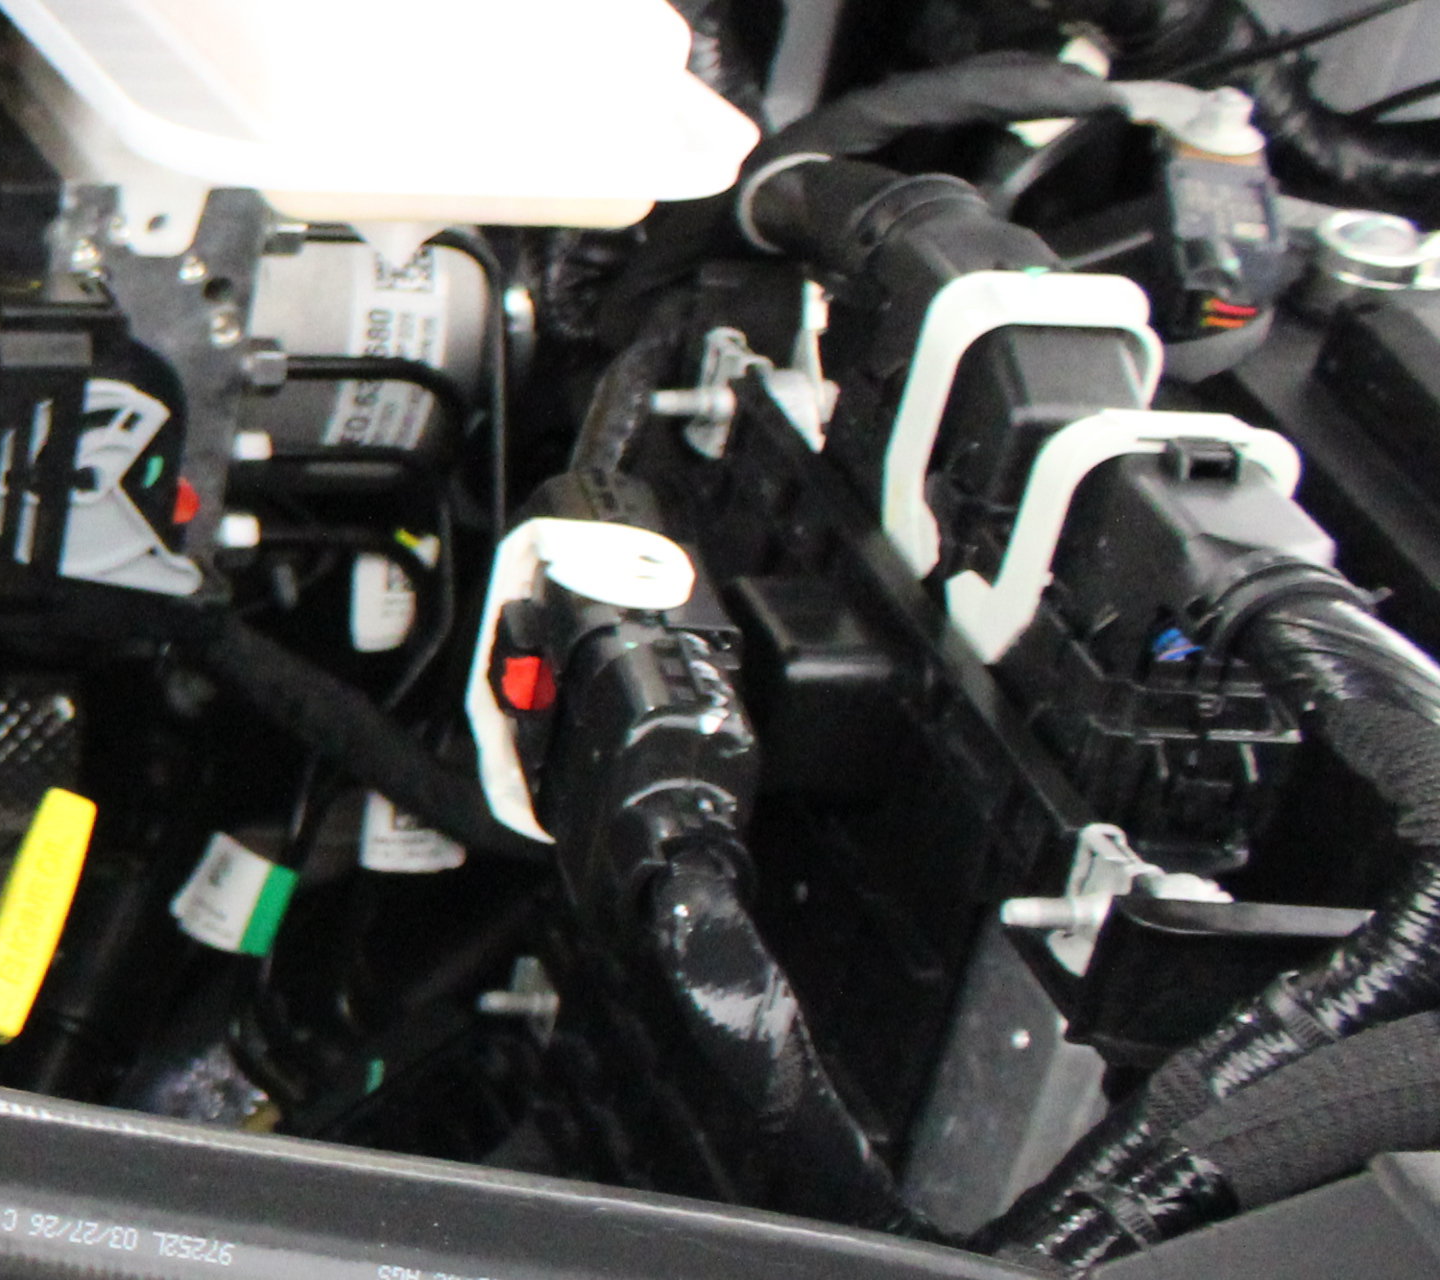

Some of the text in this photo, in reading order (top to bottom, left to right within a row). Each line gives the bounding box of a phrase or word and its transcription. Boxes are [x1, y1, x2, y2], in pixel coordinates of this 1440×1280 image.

[4, 1208, 18, 1232] C
[30, 1214, 138, 1251] 03/27/26
[153, 1231, 237, 1267] 97252L
